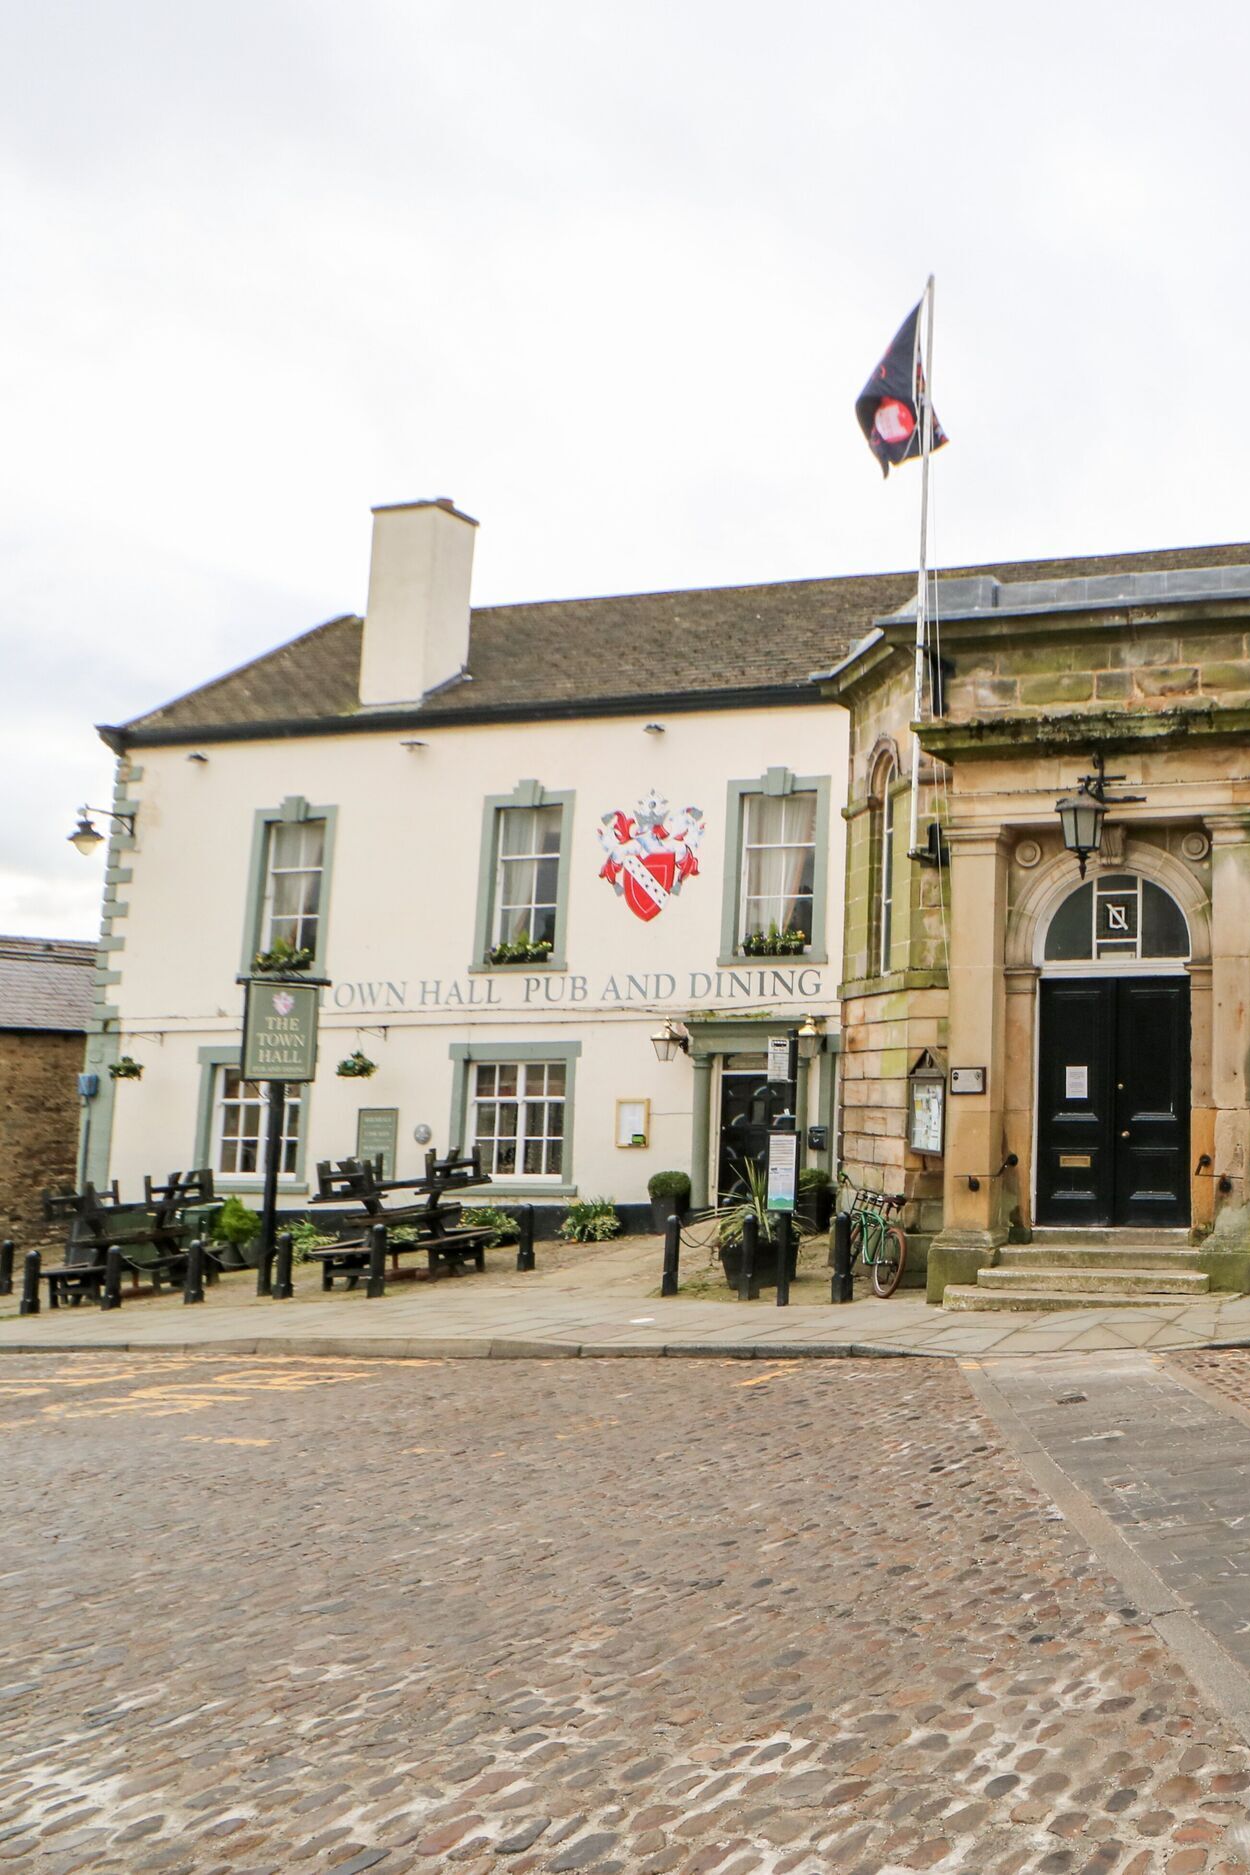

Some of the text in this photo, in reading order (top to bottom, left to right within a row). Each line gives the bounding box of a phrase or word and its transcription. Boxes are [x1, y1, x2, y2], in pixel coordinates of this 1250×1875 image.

[420, 978, 502, 1006] HALL
[523, 975, 589, 1004] PUB
[600, 973, 677, 1001] AND
[688, 968, 823, 1000] DINING
[264, 1016, 300, 1031] THE
[256, 1032, 306, 1048] TOWN
[257, 1049, 303, 1064] HALL
